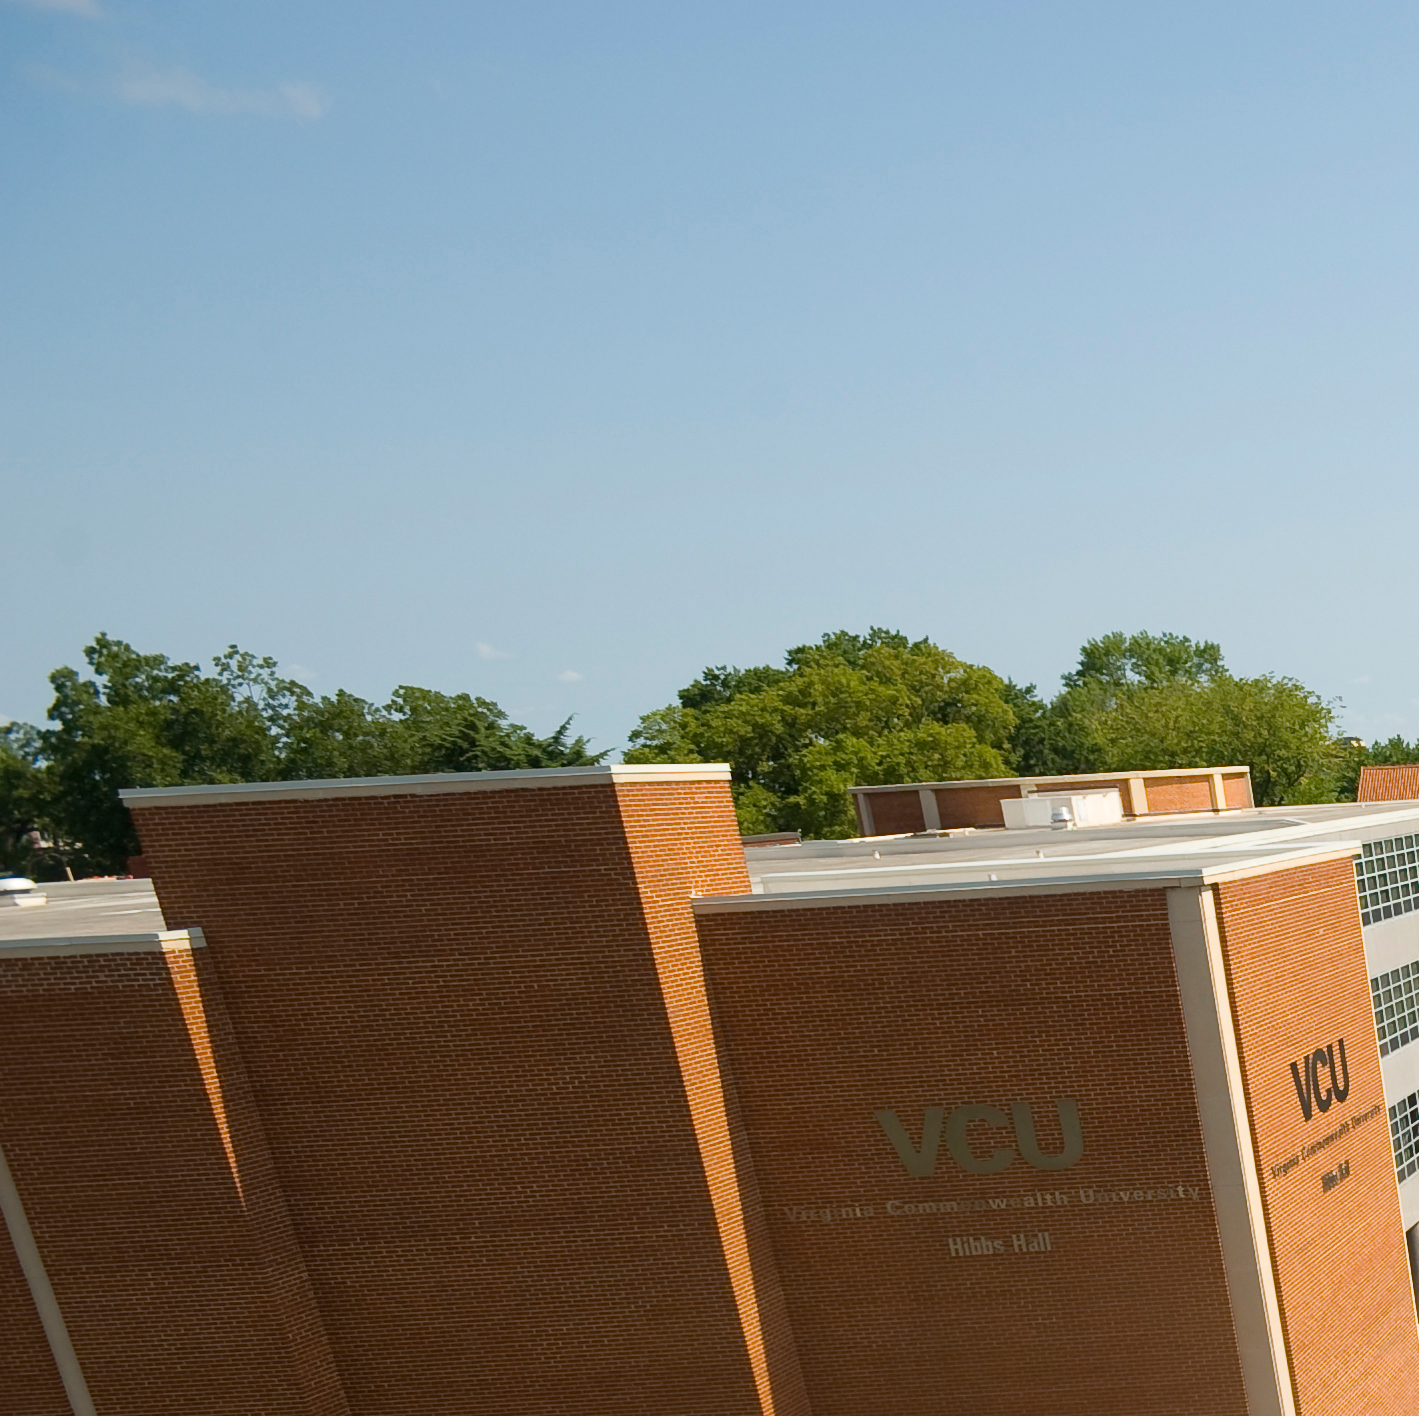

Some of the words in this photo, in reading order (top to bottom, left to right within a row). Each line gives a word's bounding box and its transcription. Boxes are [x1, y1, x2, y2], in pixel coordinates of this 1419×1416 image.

[1290, 1038, 1350, 1122] VCU
[873, 1099, 1085, 1177] VCU
[784, 1203, 874, 1222] Virginia
[886, 1191, 1068, 1216] Commonwealth
[1080, 1184, 1199, 1204] University
[949, 1235, 1004, 1257] Hibbs
[1011, 1232, 1052, 1253] Hall
